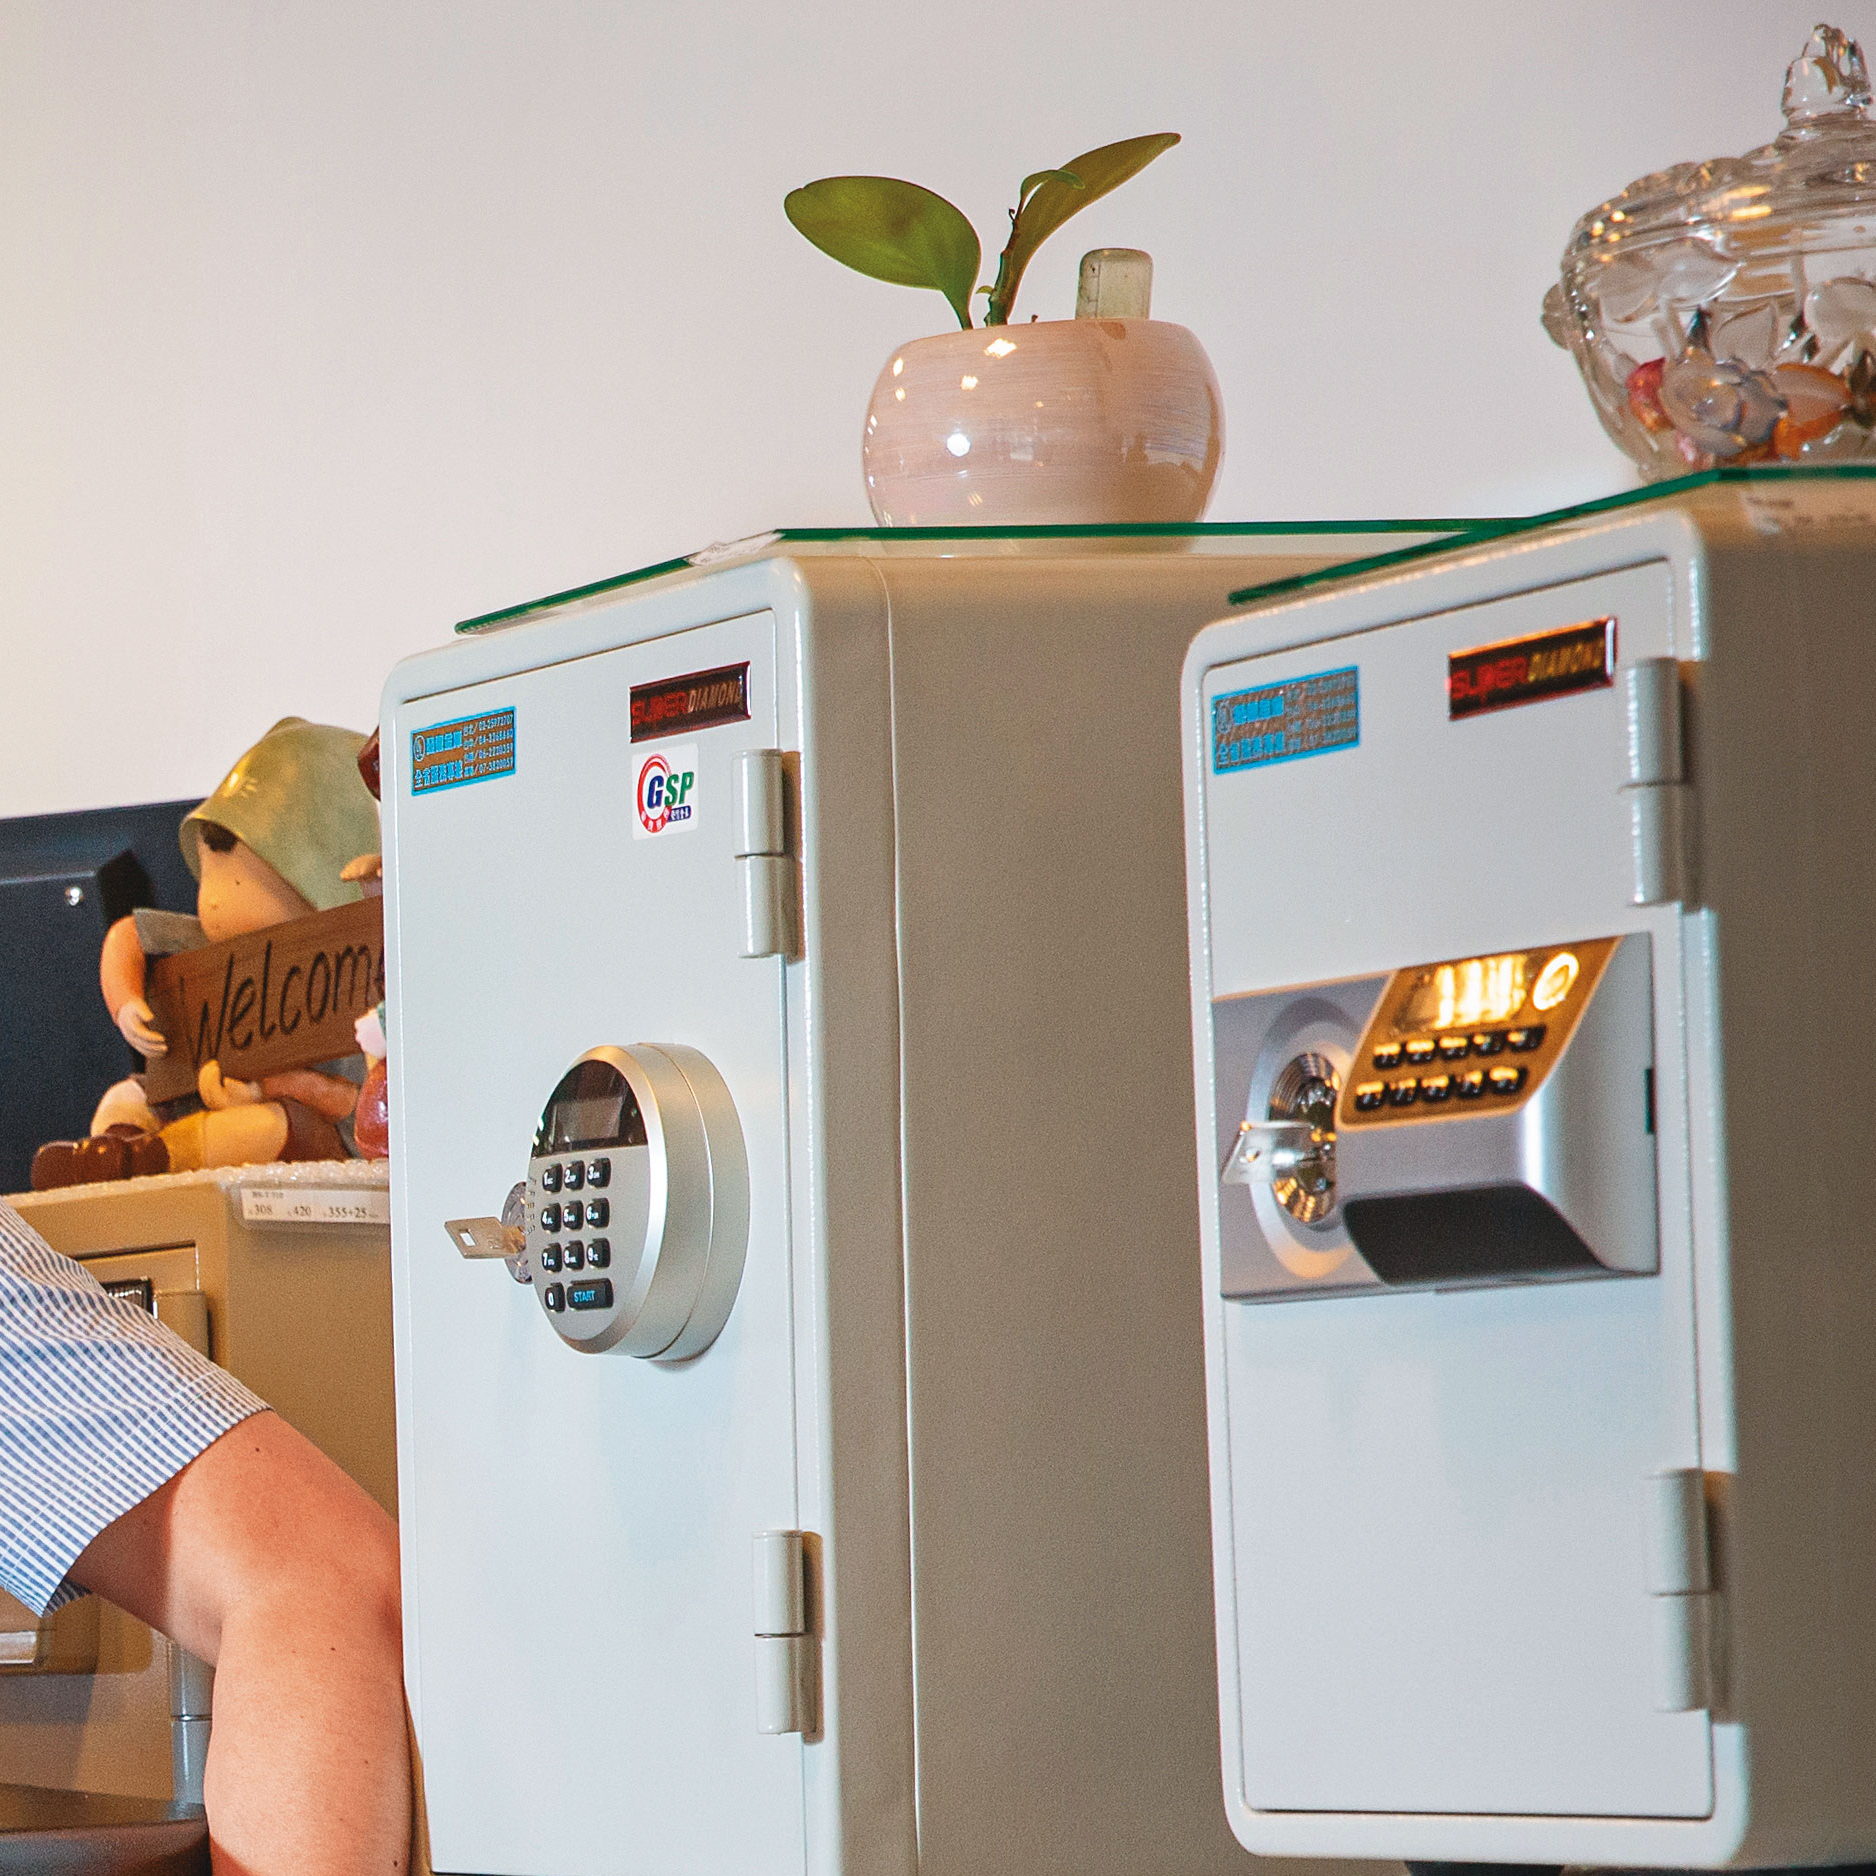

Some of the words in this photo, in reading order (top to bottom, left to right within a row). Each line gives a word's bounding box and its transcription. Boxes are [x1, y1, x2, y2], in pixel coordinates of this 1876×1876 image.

[647, 771, 694, 809] GSP
[294, 1206, 311, 1217] 420
[574, 1290, 596, 1303] START
